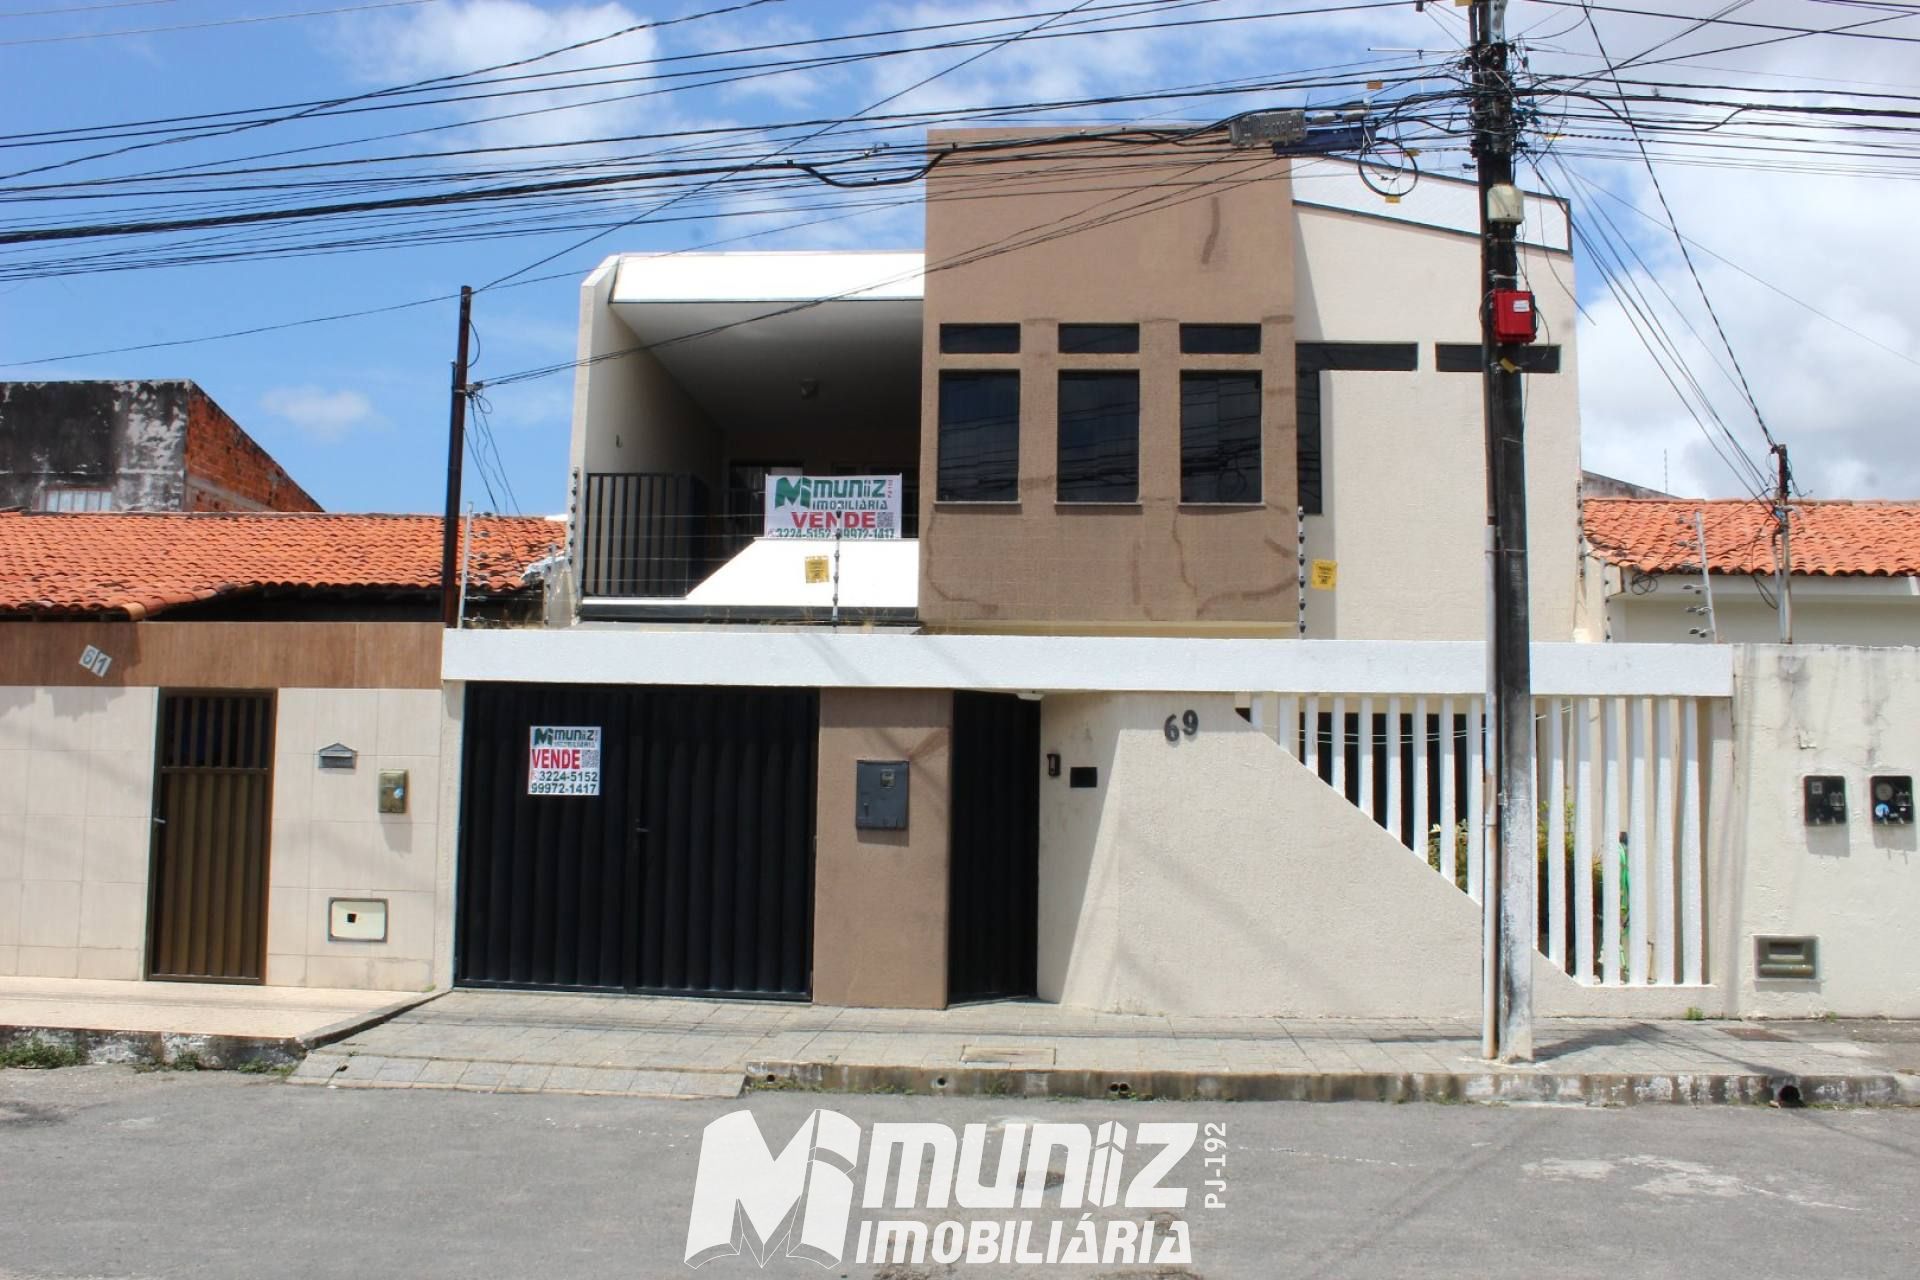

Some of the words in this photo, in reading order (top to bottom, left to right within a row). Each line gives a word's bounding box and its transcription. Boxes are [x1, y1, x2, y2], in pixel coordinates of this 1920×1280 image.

[791, 512, 876, 528] VENDE
[1164, 710, 1199, 742] 69
[531, 749, 581, 769] VENDE
[539, 771, 598, 782] 3224-5152
[531, 783, 597, 794] 99972-1417
